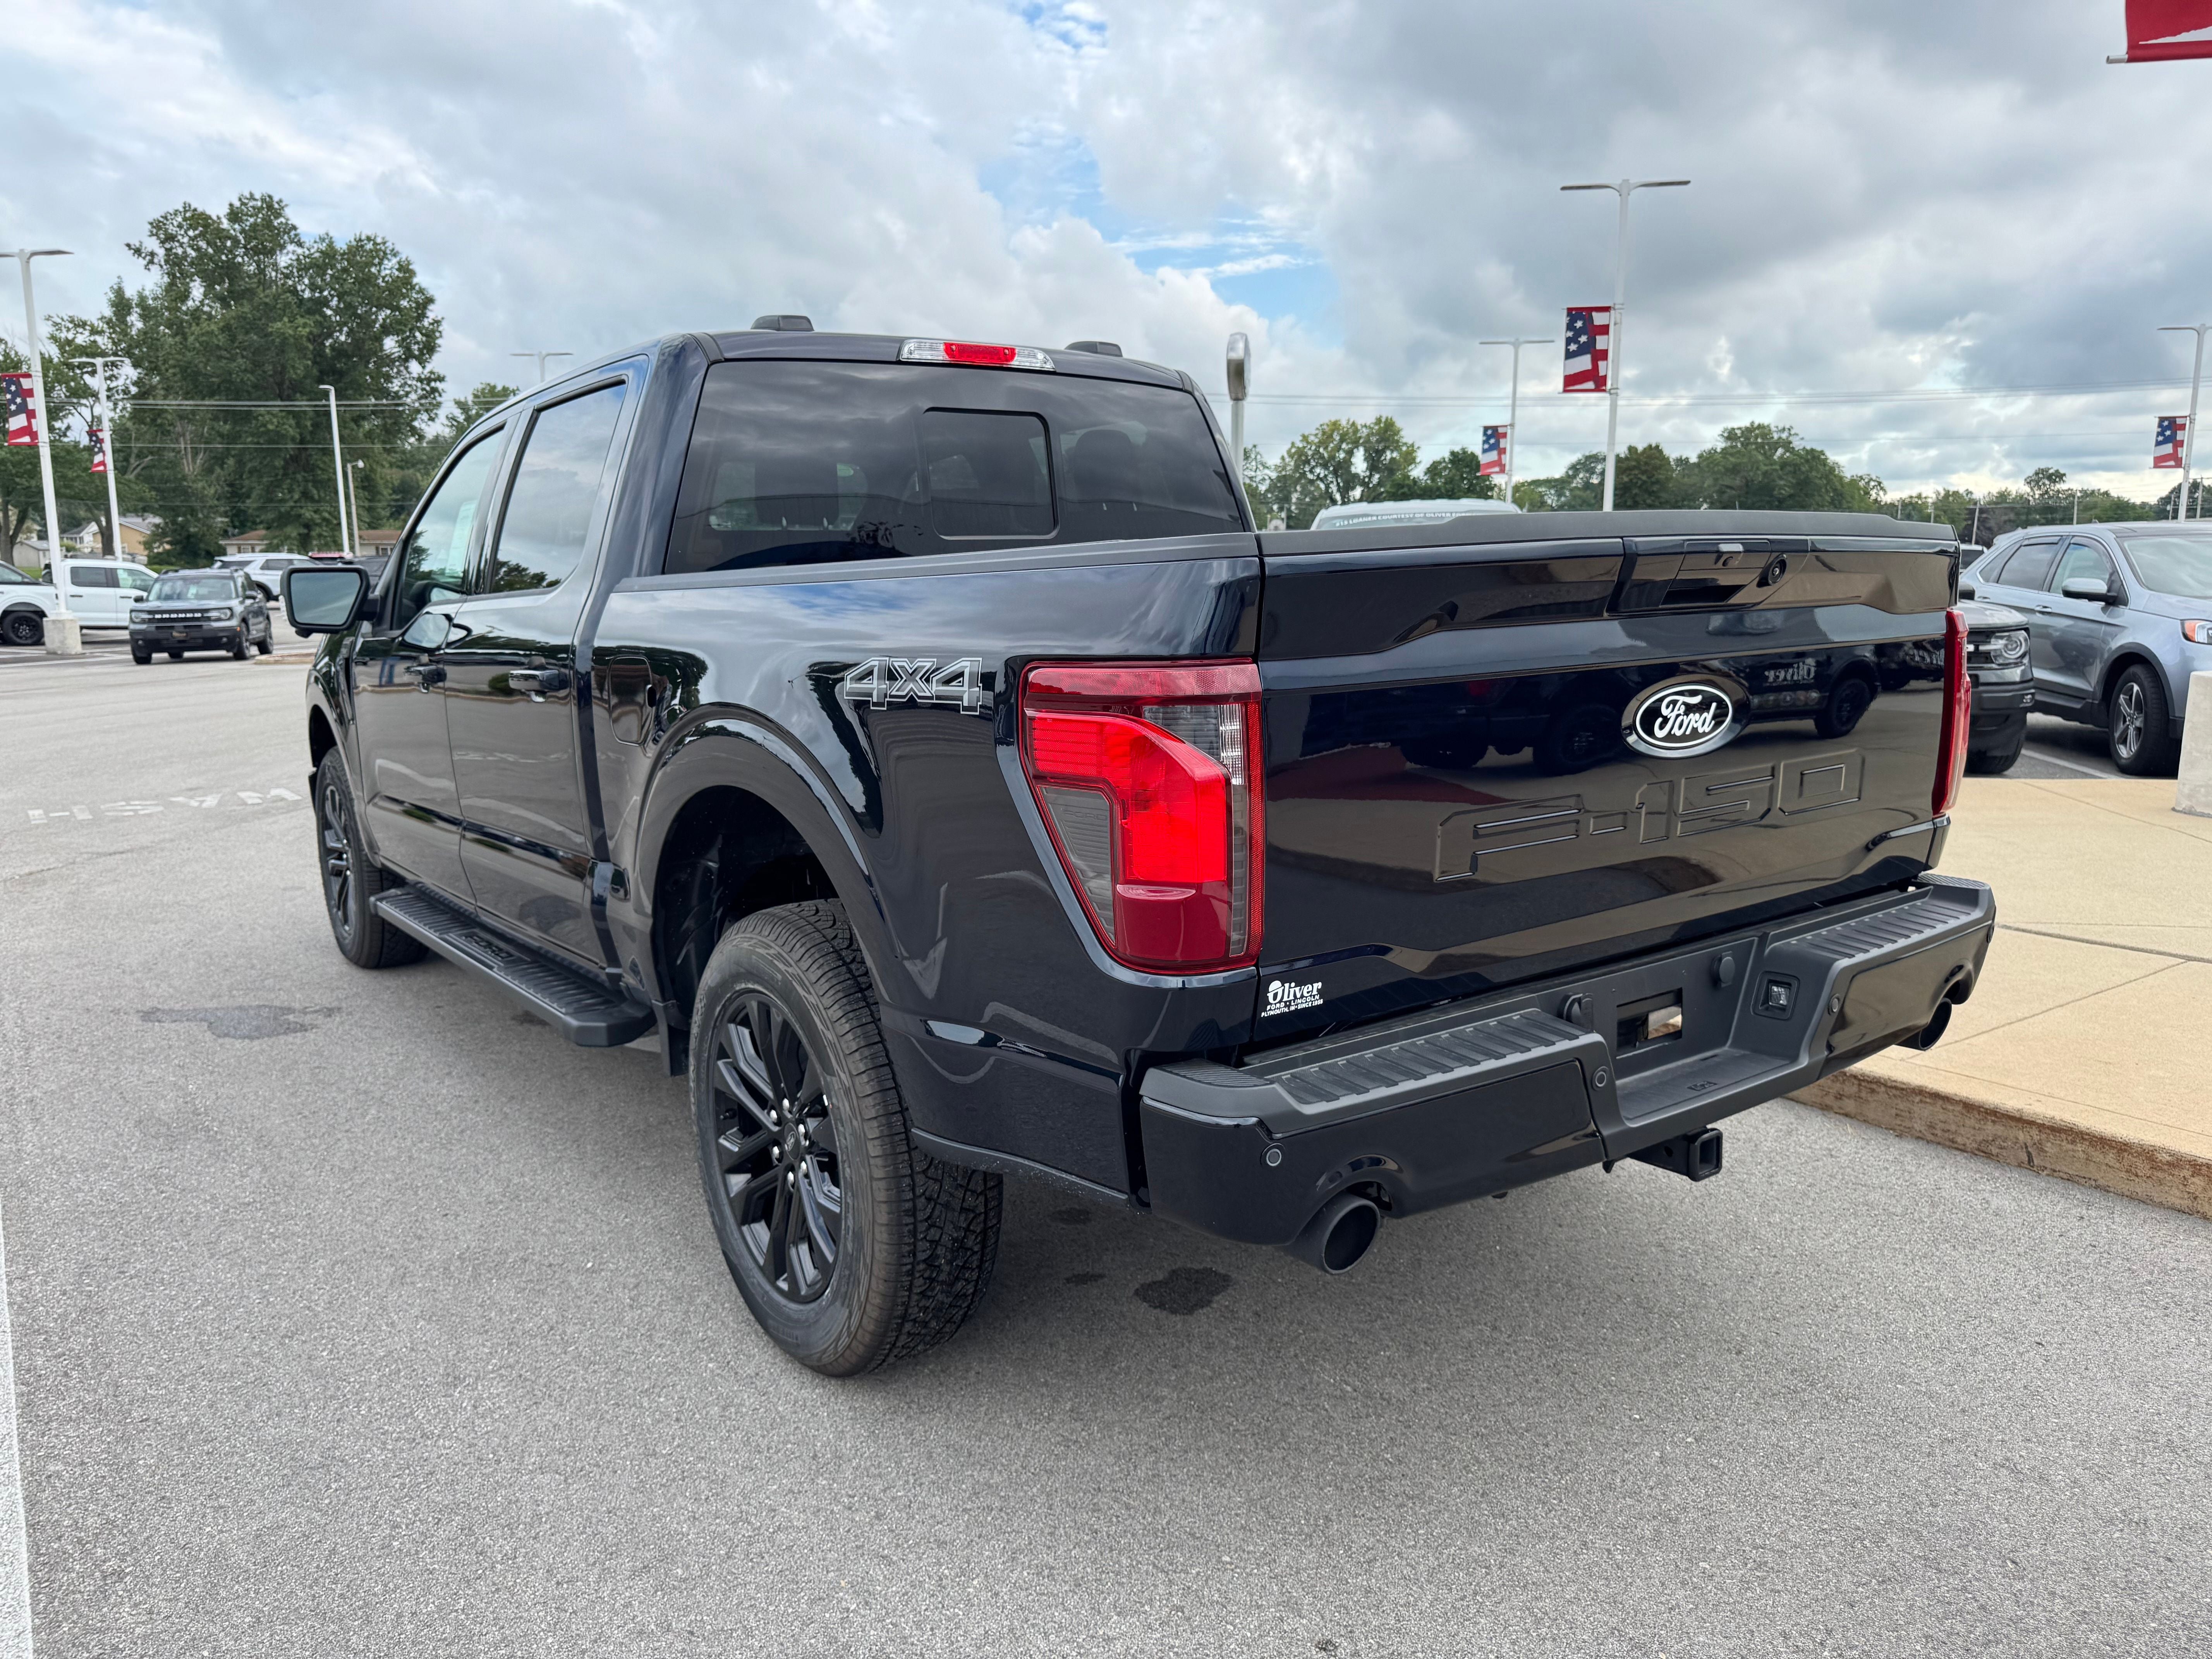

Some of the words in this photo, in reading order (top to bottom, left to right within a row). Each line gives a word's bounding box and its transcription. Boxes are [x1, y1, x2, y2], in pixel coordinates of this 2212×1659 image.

[1654, 695, 1717, 738] Ford
[1435, 748, 1864, 882] F-150
[1267, 980, 1322, 1004] Oliver
[1267, 1002, 1285, 1011] FORD
[1291, 994, 1320, 1006] LINCOLN
